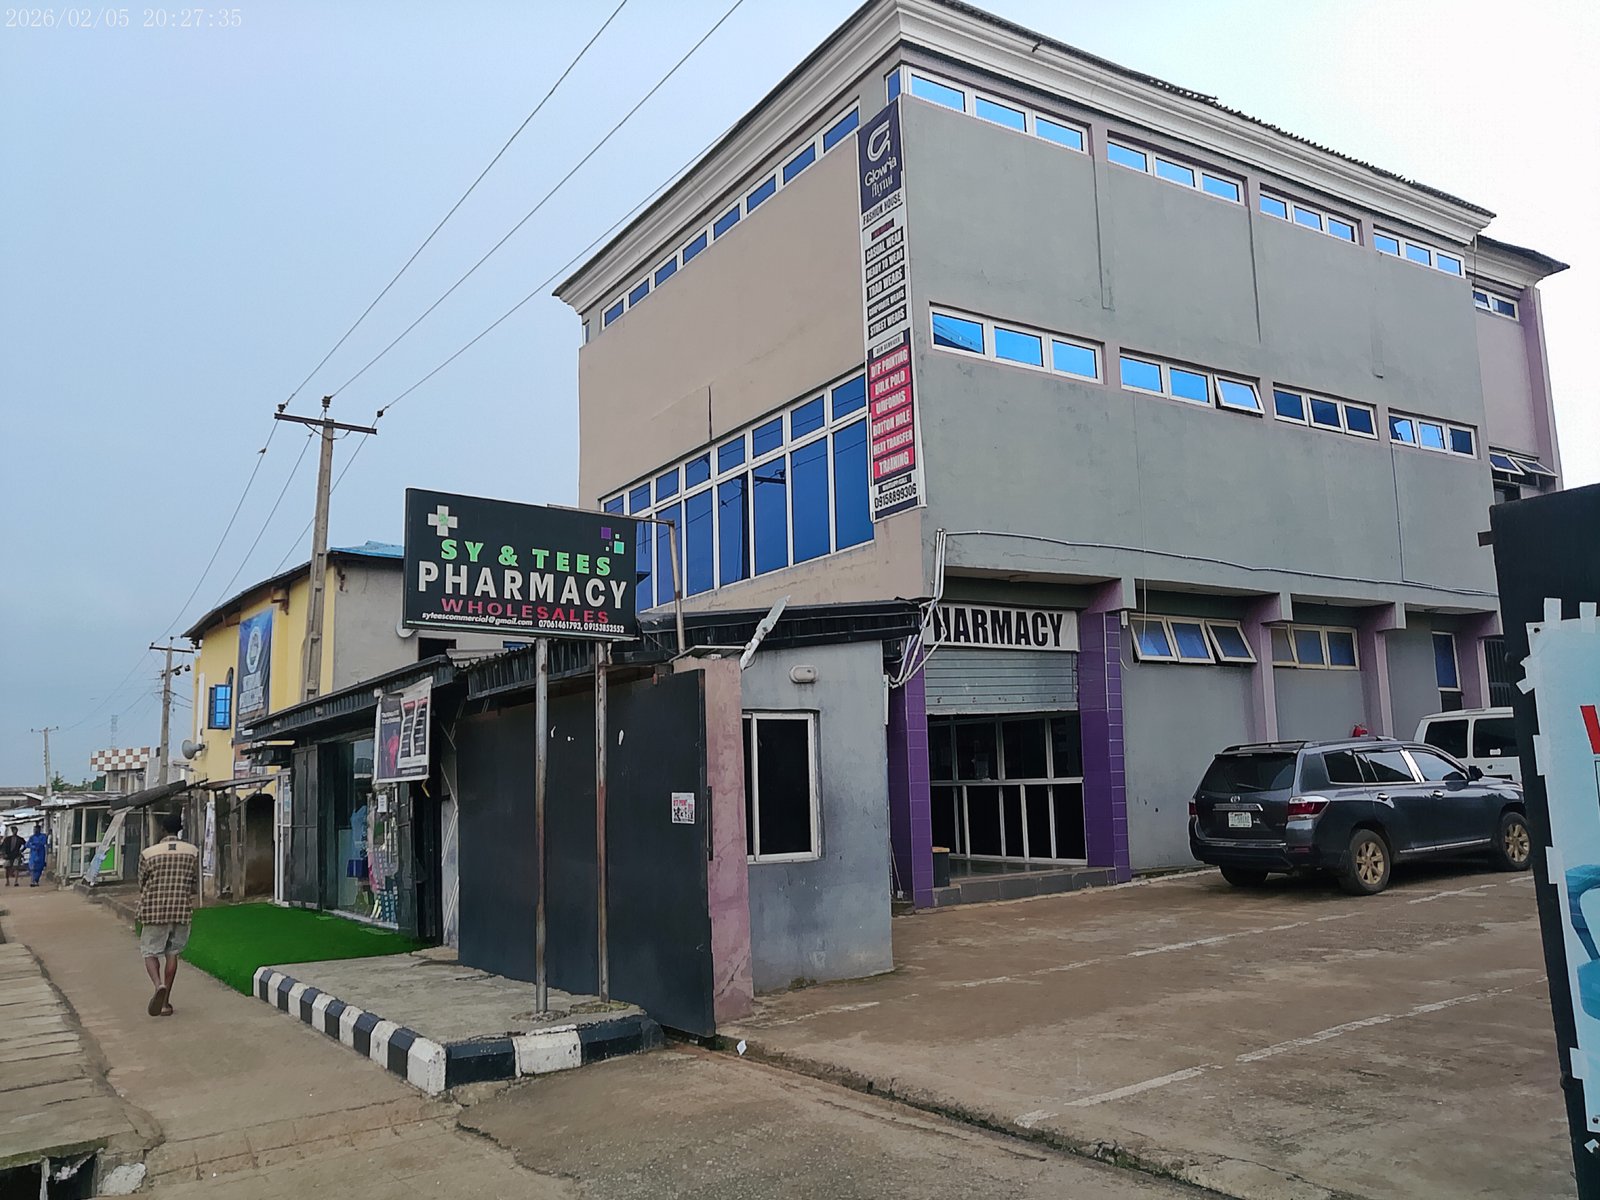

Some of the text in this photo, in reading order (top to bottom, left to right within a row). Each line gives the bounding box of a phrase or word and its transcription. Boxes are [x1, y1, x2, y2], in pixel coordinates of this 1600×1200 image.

[865, 156, 897, 187] Glowria
[863, 191, 901, 226] FASHION HOUSE
[866, 239, 886, 263] CASUAL
[886, 229, 902, 250] WEAR
[881, 256, 889, 271] TO
[870, 317, 887, 337] STREET
[890, 370, 905, 388] POLO
[880, 451, 909, 475] TRAINING
[441, 538, 611, 577] SY & TEES
[418, 560, 627, 609] PHARMACY
[441, 598, 609, 624] WHOLESALES
